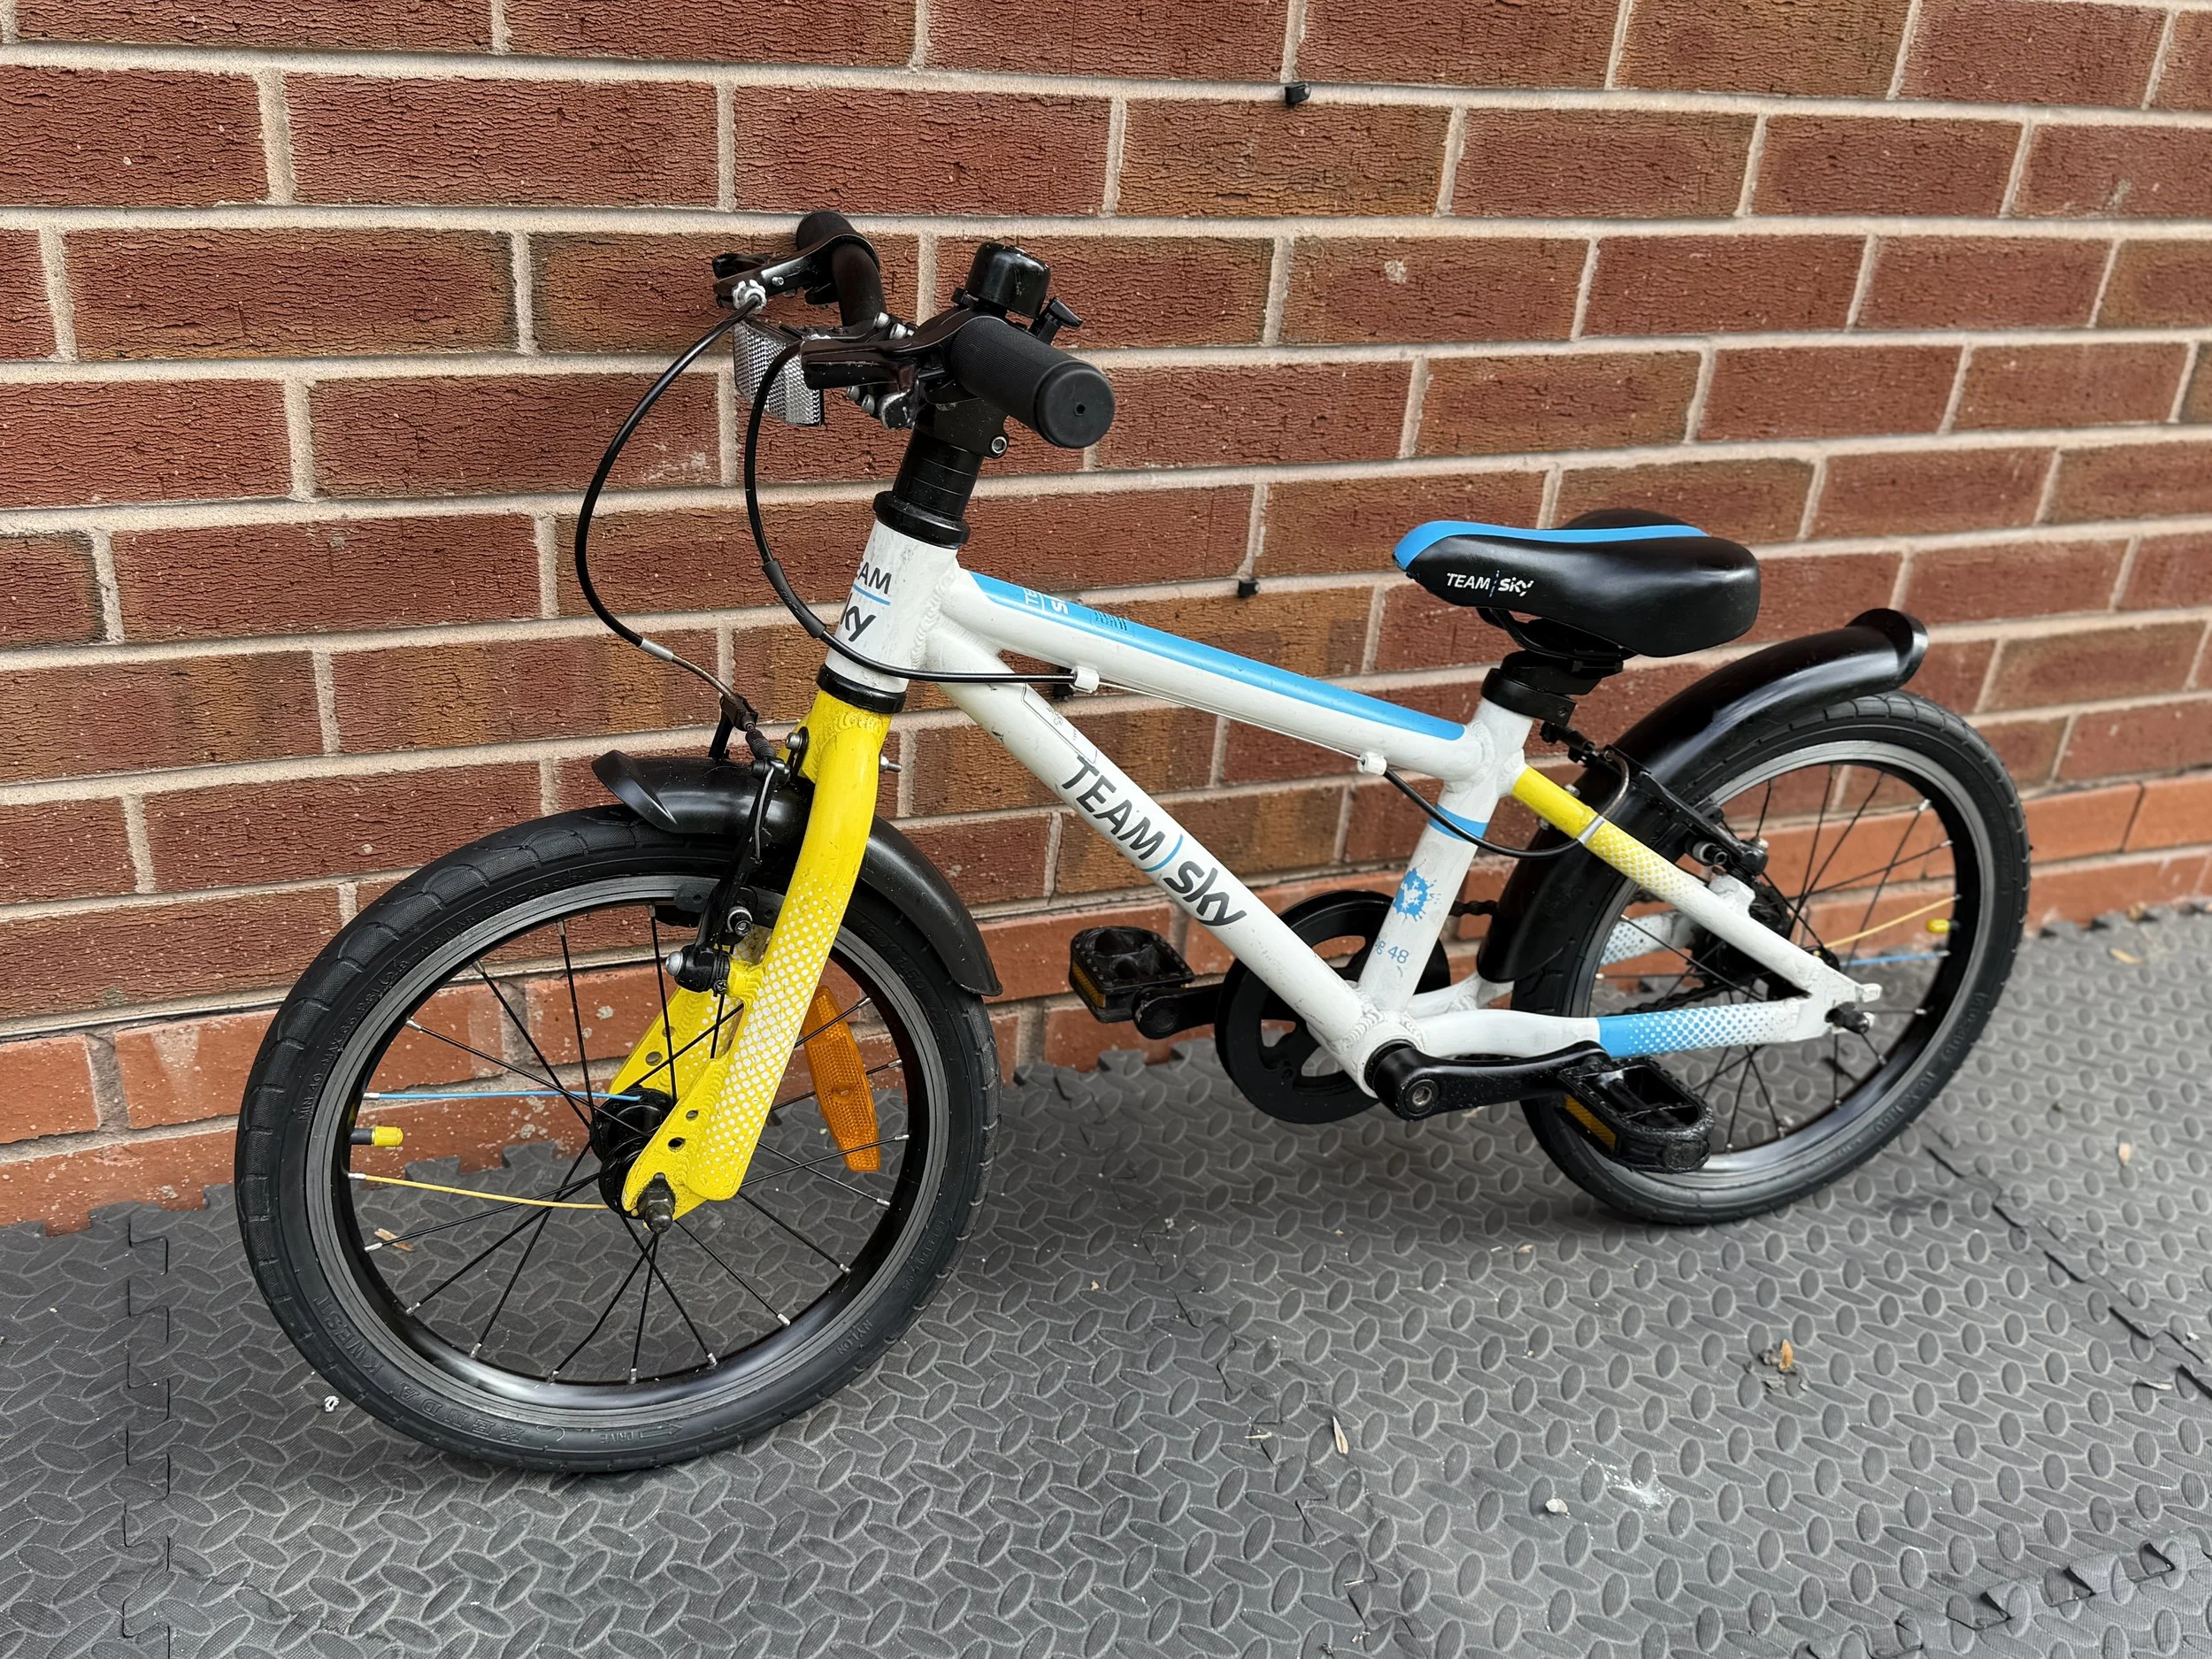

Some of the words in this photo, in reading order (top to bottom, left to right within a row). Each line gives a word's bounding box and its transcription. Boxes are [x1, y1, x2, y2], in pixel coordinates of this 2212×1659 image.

[856, 562, 892, 595] AM
[1447, 572, 1491, 590] TEAM
[1062, 754, 1165, 861] TEAM
[1387, 945, 1409, 964] 48
[311, 1295, 383, 1376] KWEST
[834, 1318, 873, 1356] NYLON
[398, 1381, 522, 1445] KENDA
[598, 1431, 634, 1443] DRIVE
